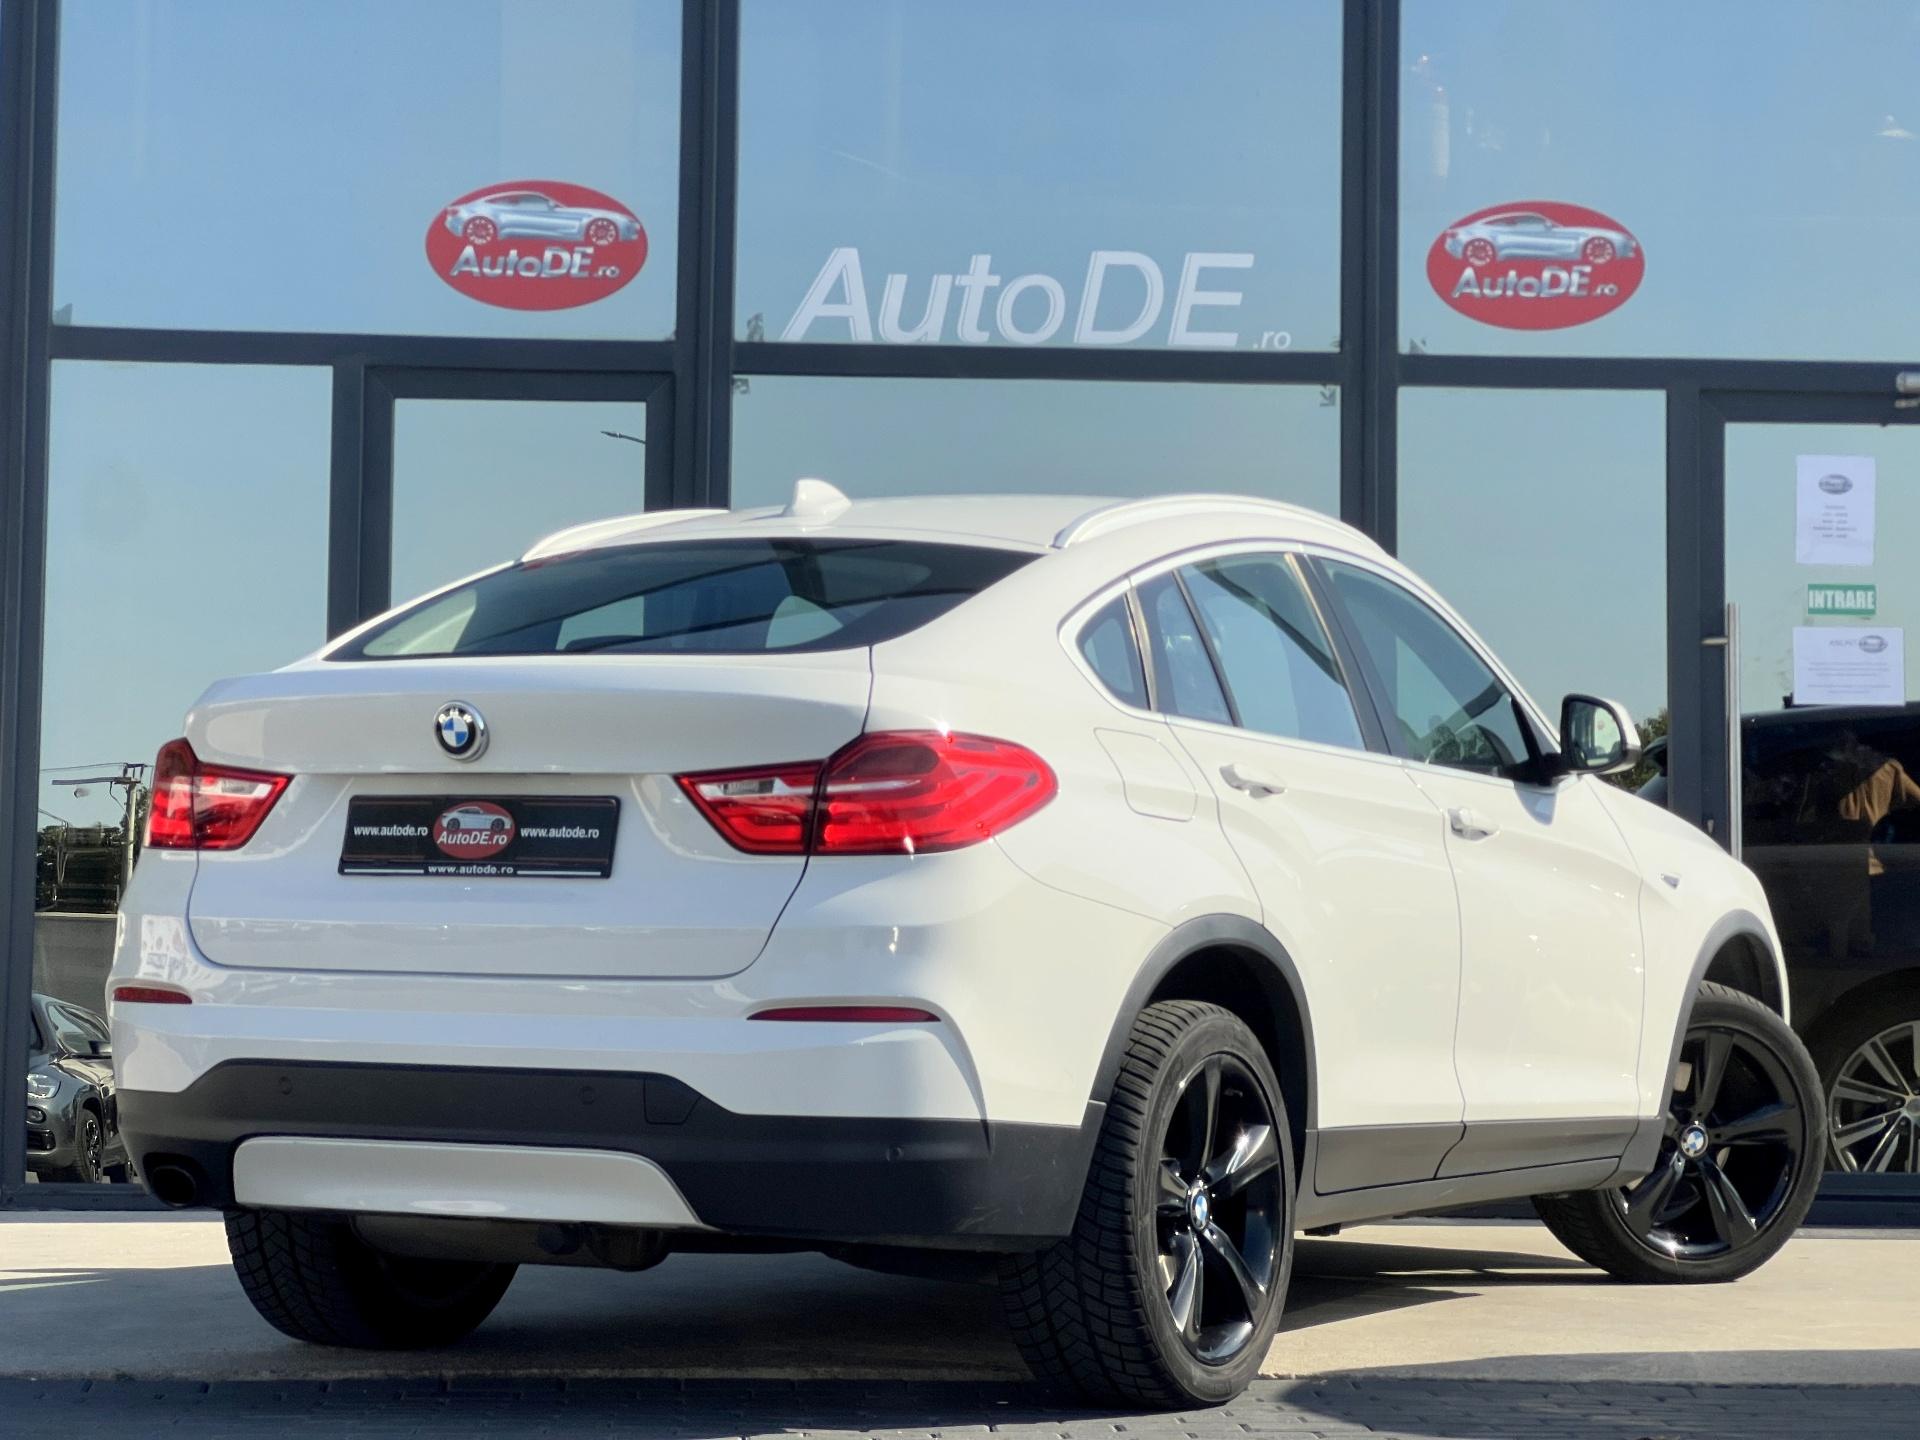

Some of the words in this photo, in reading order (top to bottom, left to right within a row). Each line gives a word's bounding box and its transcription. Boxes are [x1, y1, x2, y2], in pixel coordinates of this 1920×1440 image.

[450, 245, 620, 278] AutoDE.ro
[1452, 265, 1619, 299] AutoDE.ro
[779, 247, 1292, 351] AutoDE.ro
[1808, 589, 1875, 610] INTRARE
[354, 825, 428, 837] www.autode.ro
[437, 830, 508, 846] AutoDE.ro
[520, 826, 599, 839] www.autode.ro
[428, 864, 514, 875] www.autode.ro
